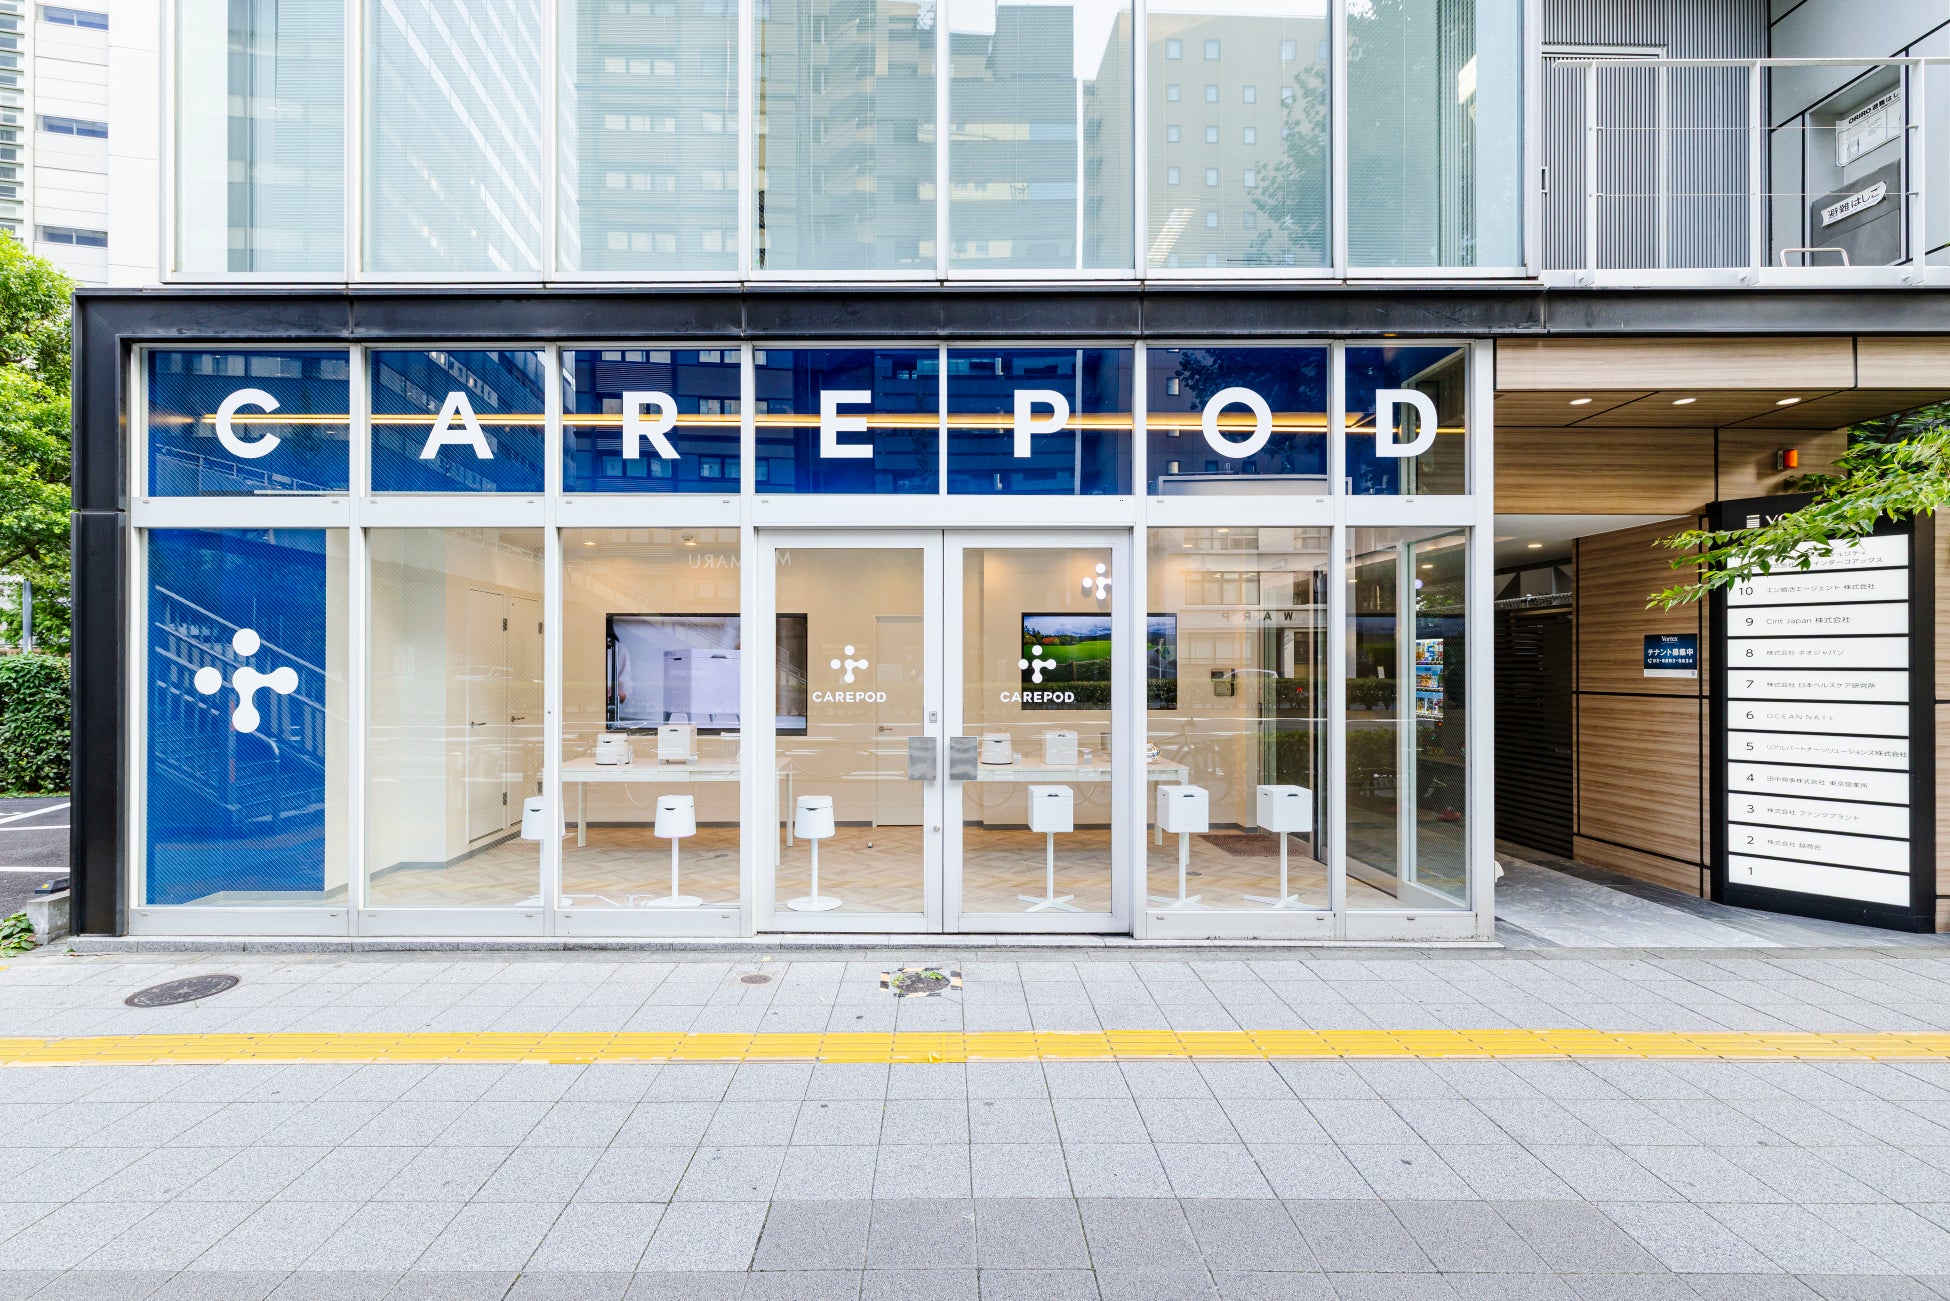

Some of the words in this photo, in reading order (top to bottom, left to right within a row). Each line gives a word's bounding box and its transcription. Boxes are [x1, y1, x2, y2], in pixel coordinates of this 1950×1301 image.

[1848, 107, 1872, 124] ORIRO
[1827, 185, 1881, 220] 避難はしご
[214, 386, 1439, 460] CAREPOD
[1738, 586, 1754, 596] 10
[1745, 617, 1754, 627] 9
[1766, 617, 1783, 625] Cint
[1786, 617, 1812, 626] Japan
[1815, 616, 1851, 624] 株式会社
[1647, 648, 1694, 656] テナント募集中
[1745, 648, 1754, 658] 8
[1745, 679, 1754, 689] 7
[812, 691, 887, 703] CAREPOD
[999, 691, 1075, 703] CAREPOD
[1746, 710, 1755, 720] 6
[1746, 741, 1754, 751] 5
[1746, 773, 1754, 782] 4
[1746, 804, 1755, 814] 3
[1746, 835, 1755, 845] 2
[1747, 867, 1753, 876] 1
